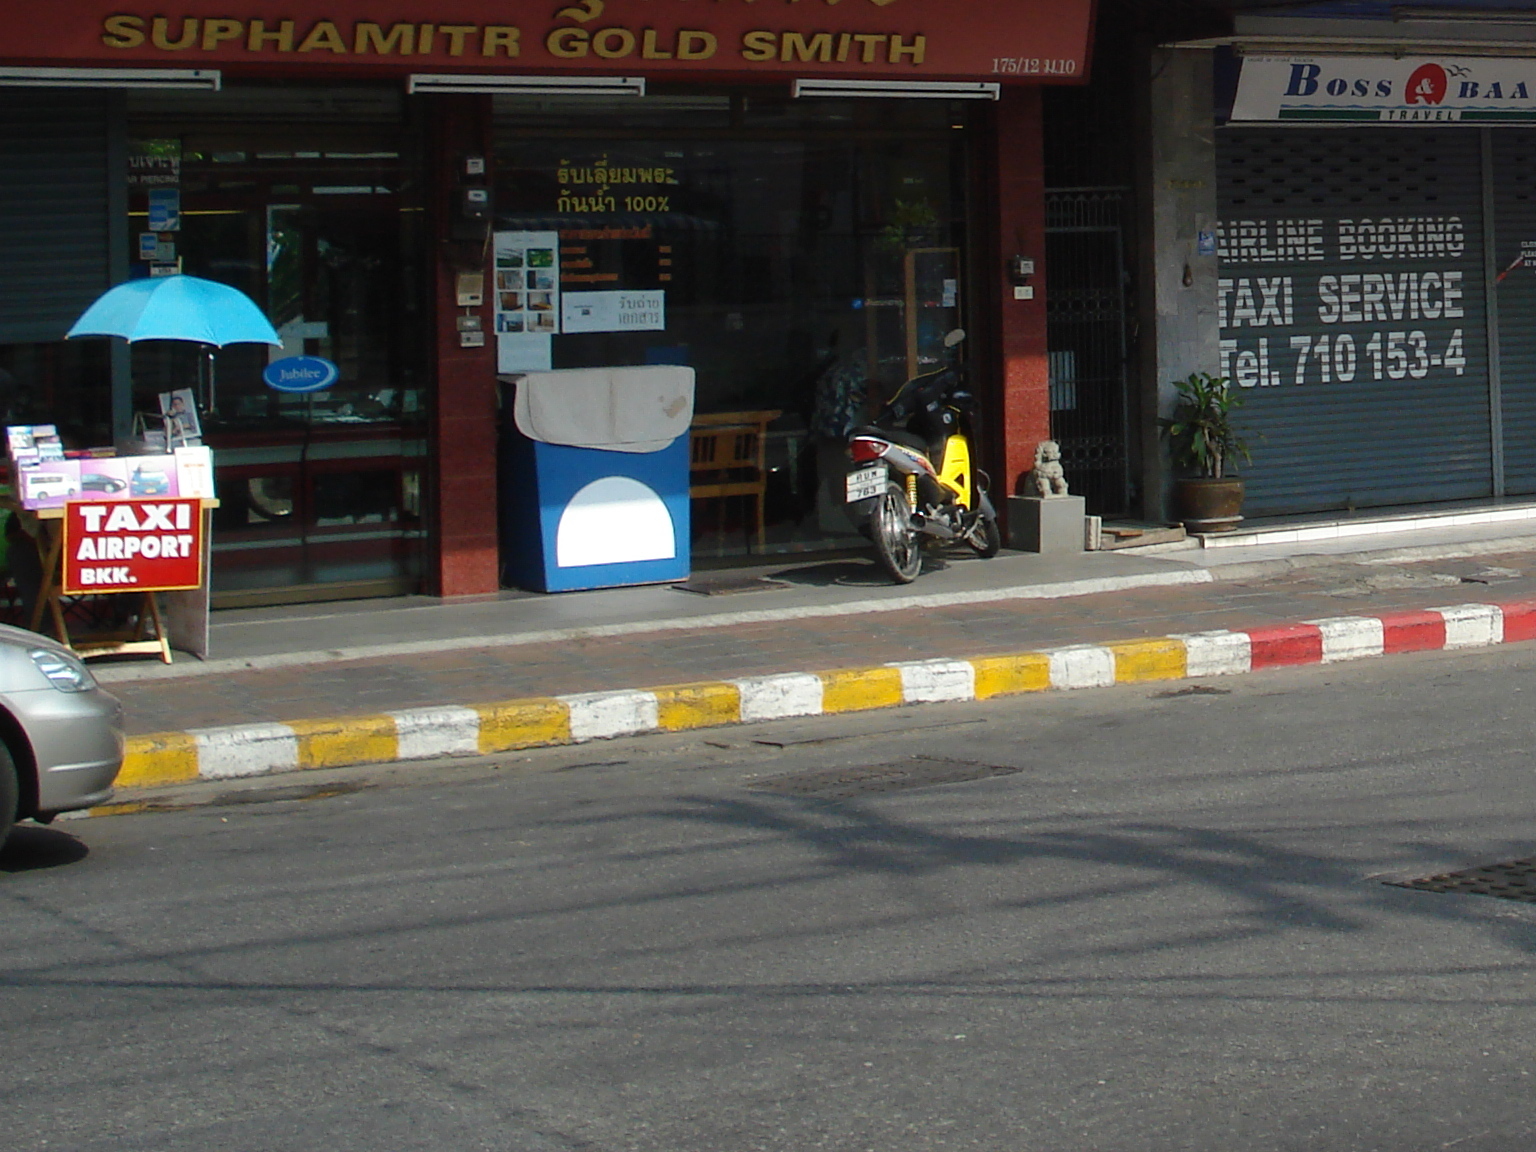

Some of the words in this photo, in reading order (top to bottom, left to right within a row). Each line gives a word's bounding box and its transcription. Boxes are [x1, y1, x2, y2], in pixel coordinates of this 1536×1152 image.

[102, 15, 521, 58] SUPHAMITR
[546, 26, 718, 60] GOLD
[742, 30, 926, 65] SMITH
[991, 57, 1040, 75] 175/12
[1414, 77, 1435, 96] &
[1388, 110, 1456, 122] TRAVEL
[557, 154, 676, 185] รับเลี่ยมพระ
[557, 185, 616, 212] กันน้ำ
[624, 195, 670, 212] 100%
[1338, 216, 1465, 260] BOOKING
[1218, 276, 1295, 328] TAXI
[1318, 271, 1465, 323] SERVICE
[1219, 337, 1282, 388] Tel.
[1290, 333, 1357, 385] 710
[1366, 328, 1467, 380] 153-4
[279, 368, 321, 382] Jubilee
[79, 503, 191, 532] TAXI
[76, 534, 193, 560] AIRPORT
[80, 566, 138, 585] BKK.
